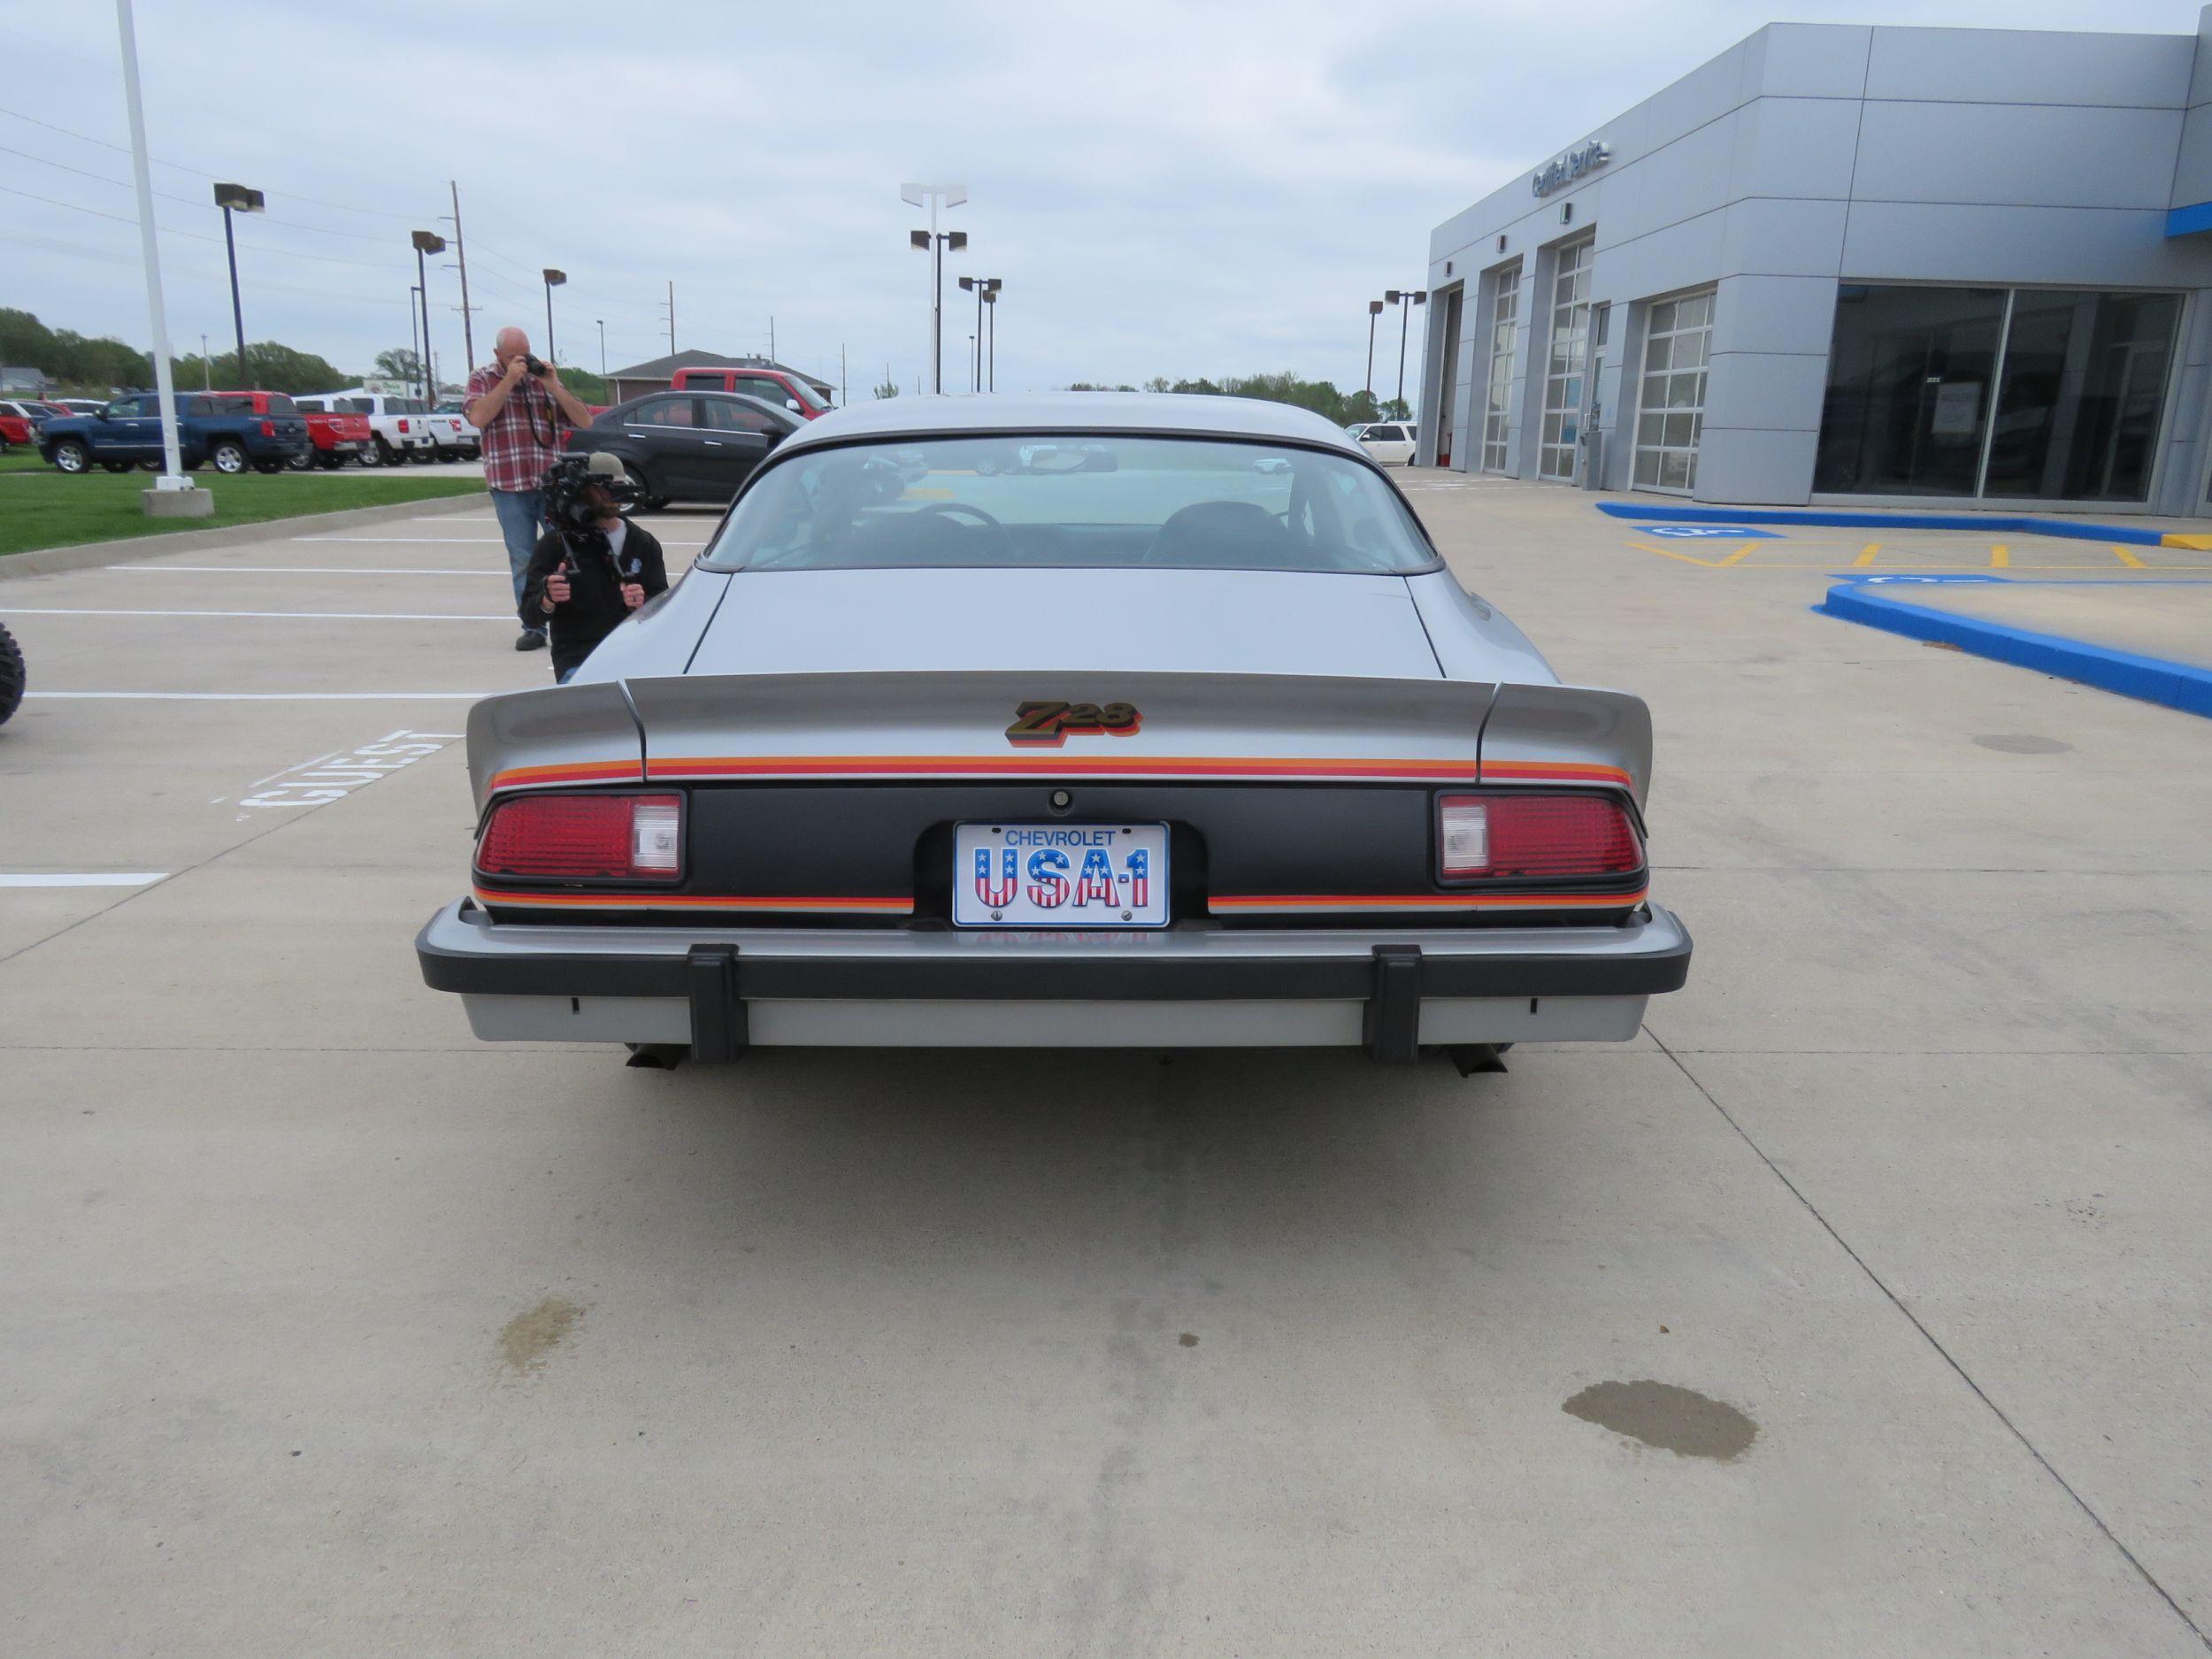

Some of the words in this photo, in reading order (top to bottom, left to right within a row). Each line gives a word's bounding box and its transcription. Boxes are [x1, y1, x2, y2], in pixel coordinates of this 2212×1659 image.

[1004, 701, 1144, 748] Z28
[239, 729, 466, 807] GUEST
[1005, 830, 1116, 847] CHEVROLET
[973, 848, 1150, 909] USA-1
